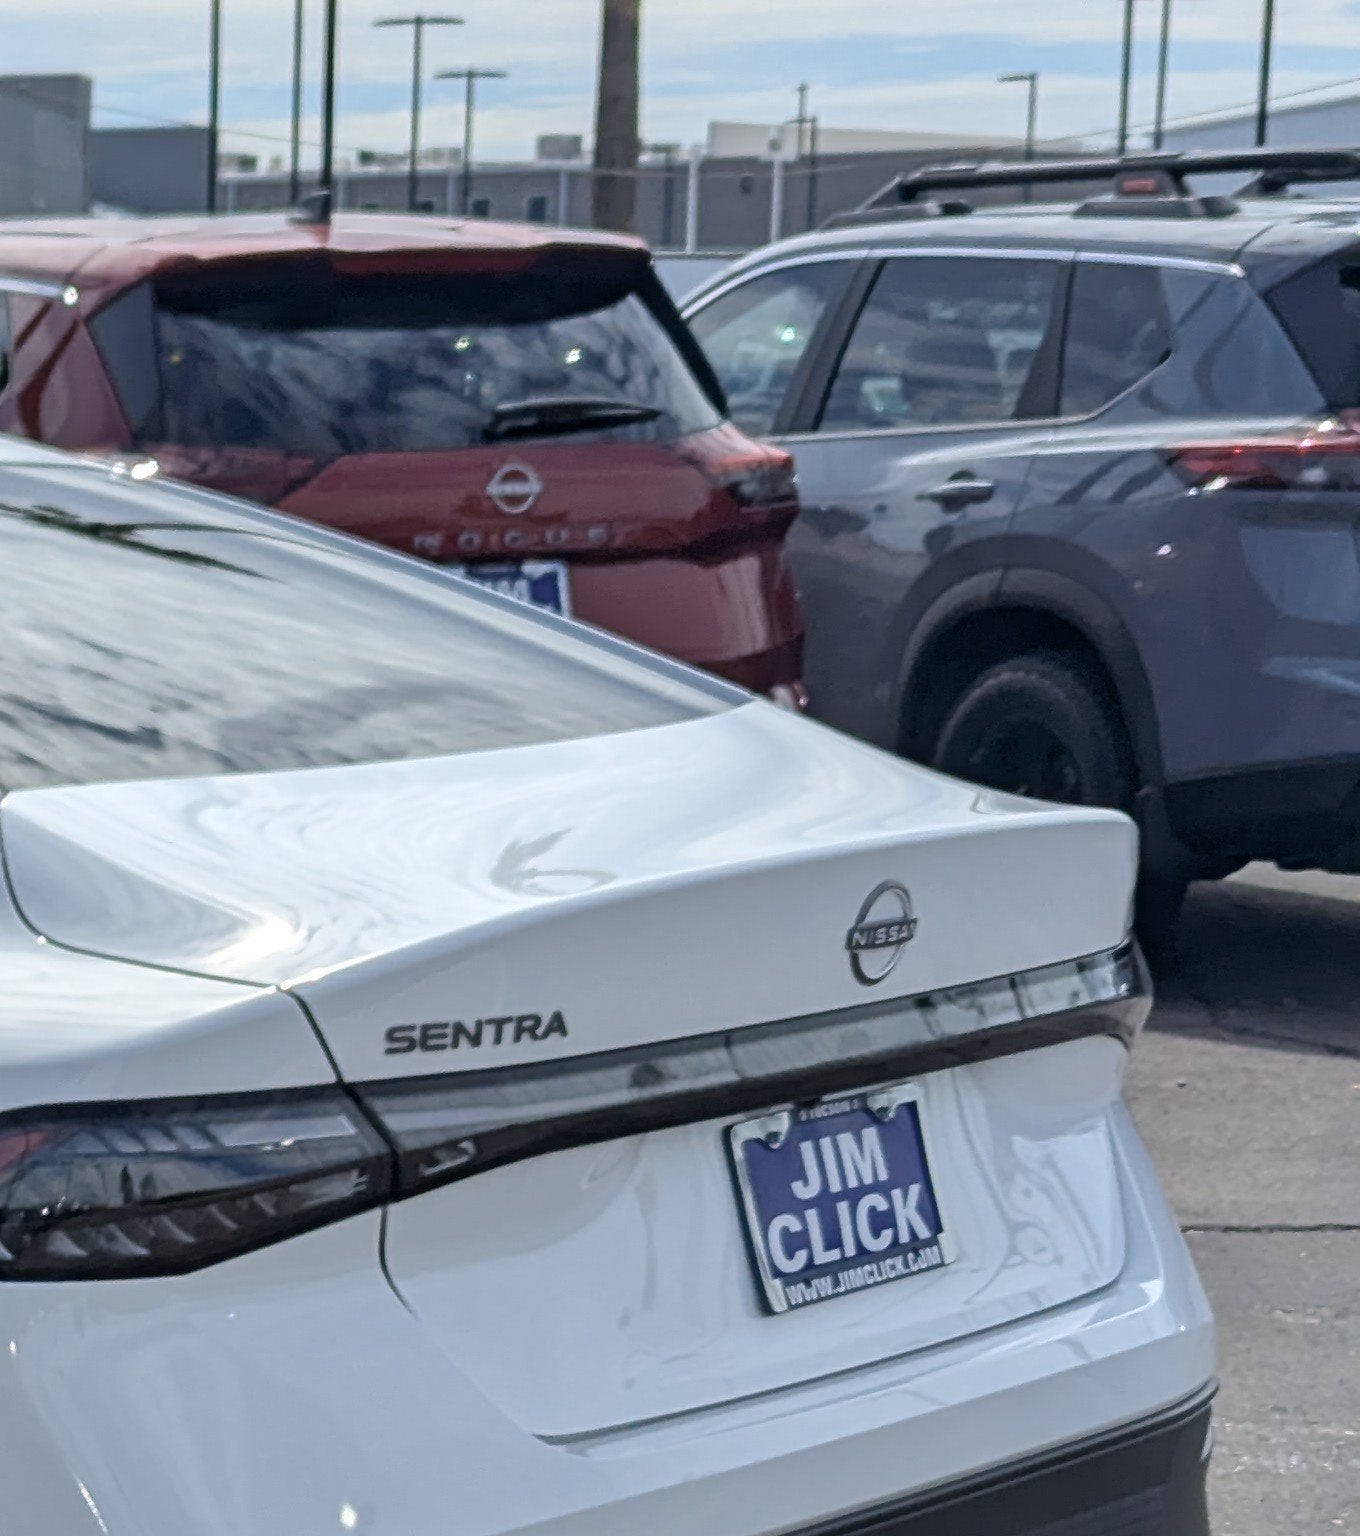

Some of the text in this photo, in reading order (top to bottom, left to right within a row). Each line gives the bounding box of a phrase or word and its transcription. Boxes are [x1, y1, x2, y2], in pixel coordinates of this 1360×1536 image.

[384, 1010, 568, 1055] SENTRA
[790, 1126, 889, 1200] JIM
[767, 1182, 932, 1274] CLICK
